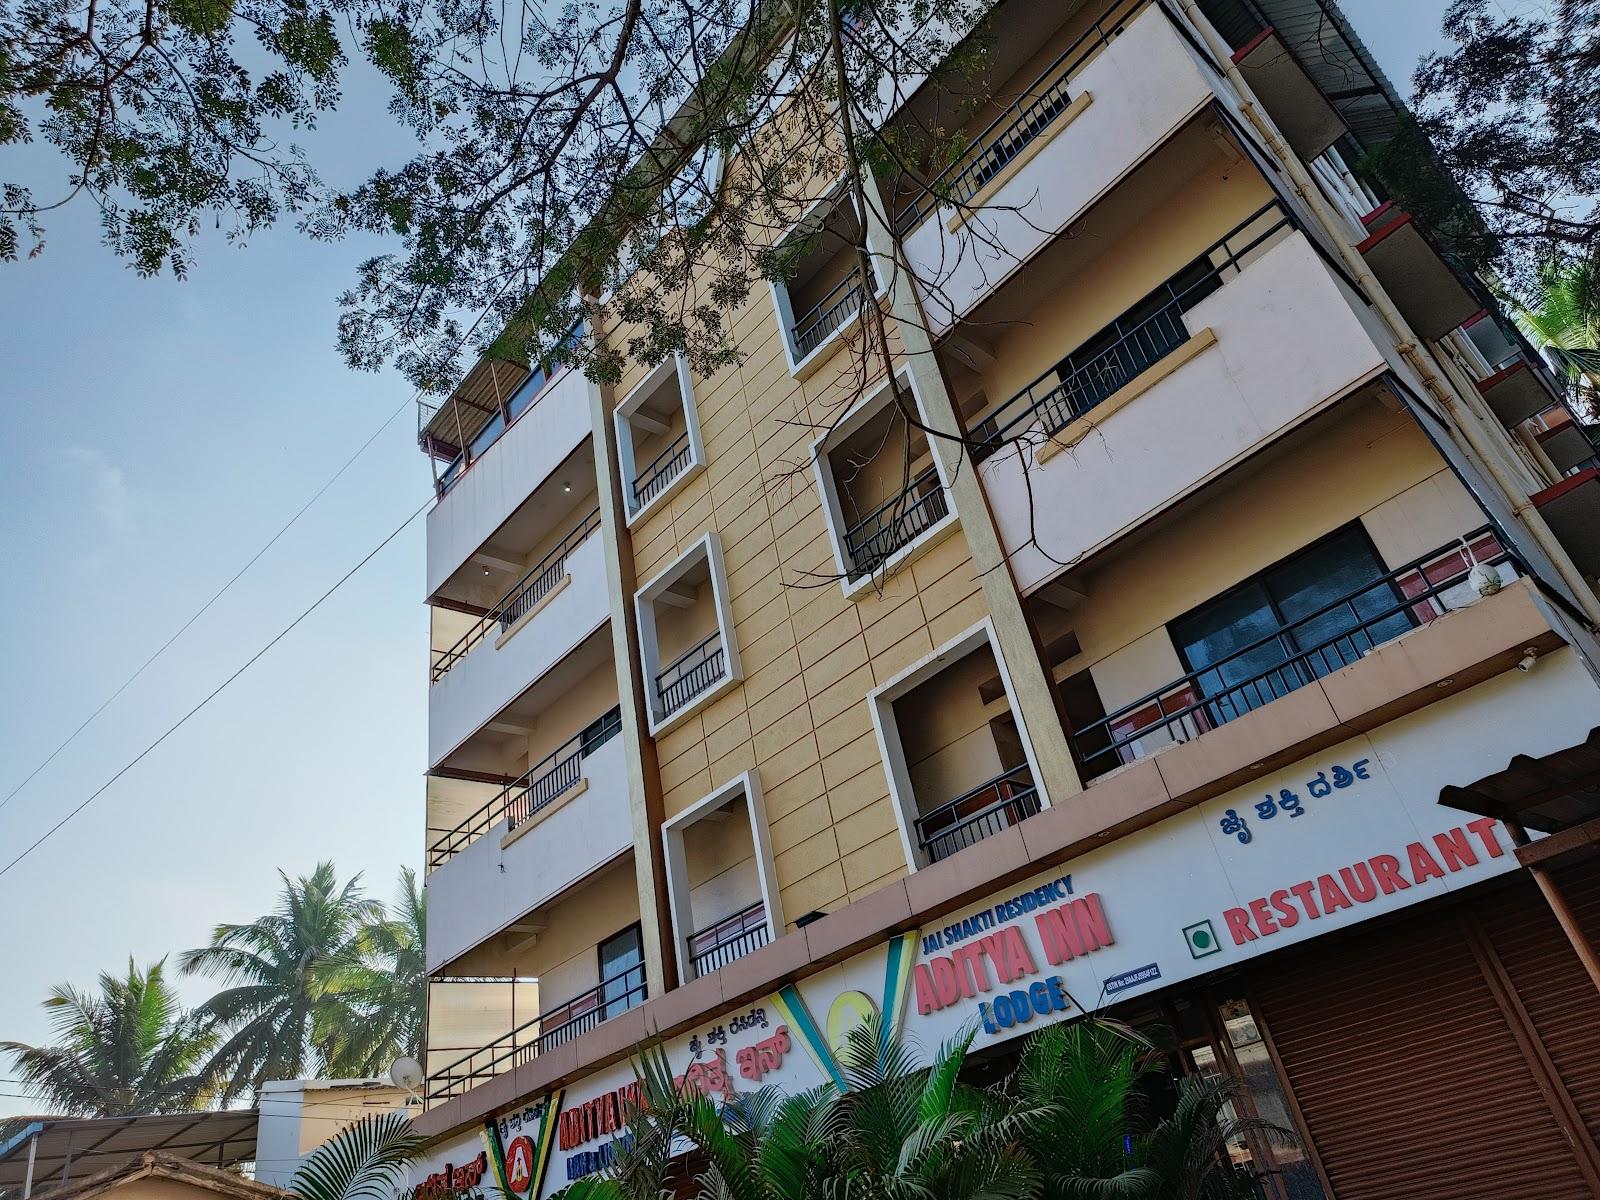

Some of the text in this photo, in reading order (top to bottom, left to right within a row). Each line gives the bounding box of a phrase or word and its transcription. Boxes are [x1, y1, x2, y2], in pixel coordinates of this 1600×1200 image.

[1220, 809, 1253, 844] ಜೈ
[1255, 789, 1305, 818] ಶಕ್ತಿ
[923, 874, 1075, 955] JAI SHAKTI RESIDENCY
[1223, 818, 1504, 945] RESTAURANT
[914, 893, 1115, 1015] ADITYA INN
[978, 975, 1070, 1034] LODGE
